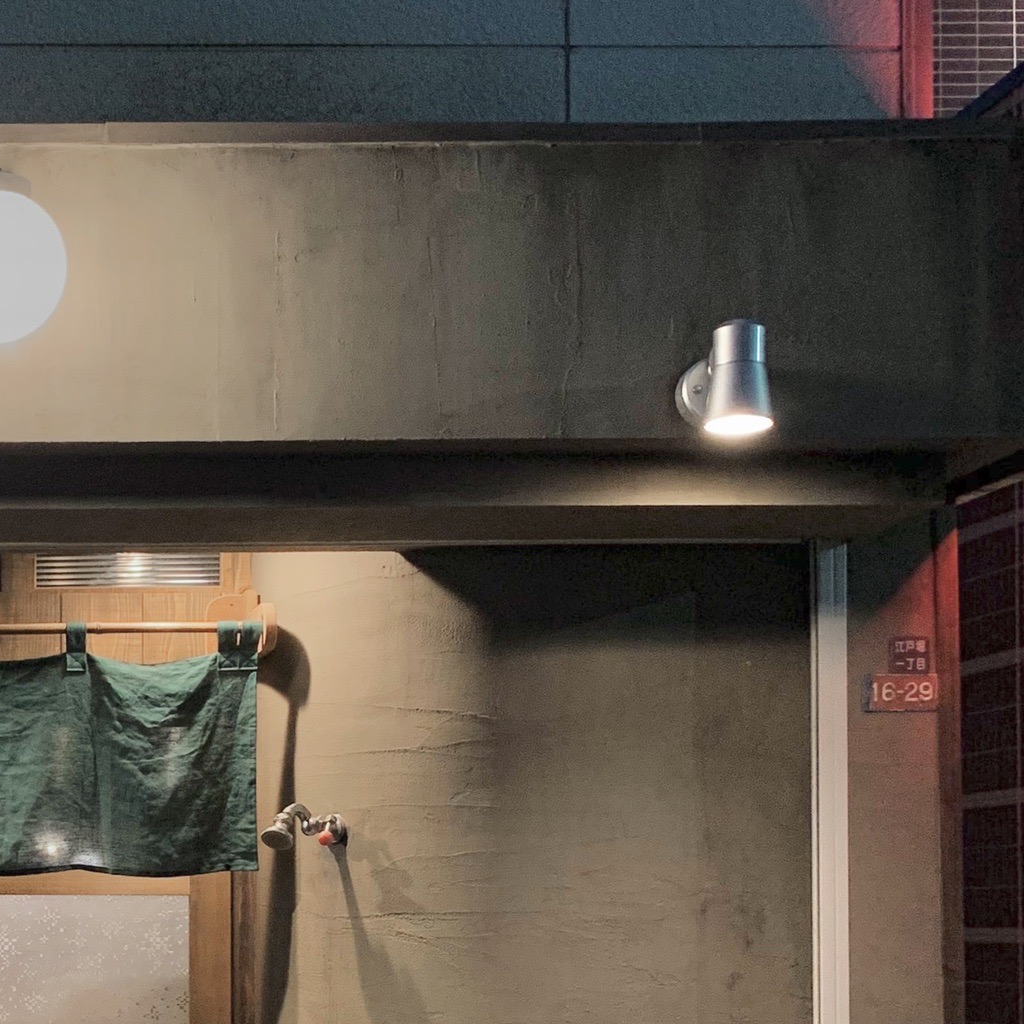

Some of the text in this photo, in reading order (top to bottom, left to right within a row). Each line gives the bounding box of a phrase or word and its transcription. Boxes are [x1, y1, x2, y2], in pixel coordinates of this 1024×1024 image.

[895, 657, 926, 671] 一丁目
[872, 681, 933, 702] 16-29
